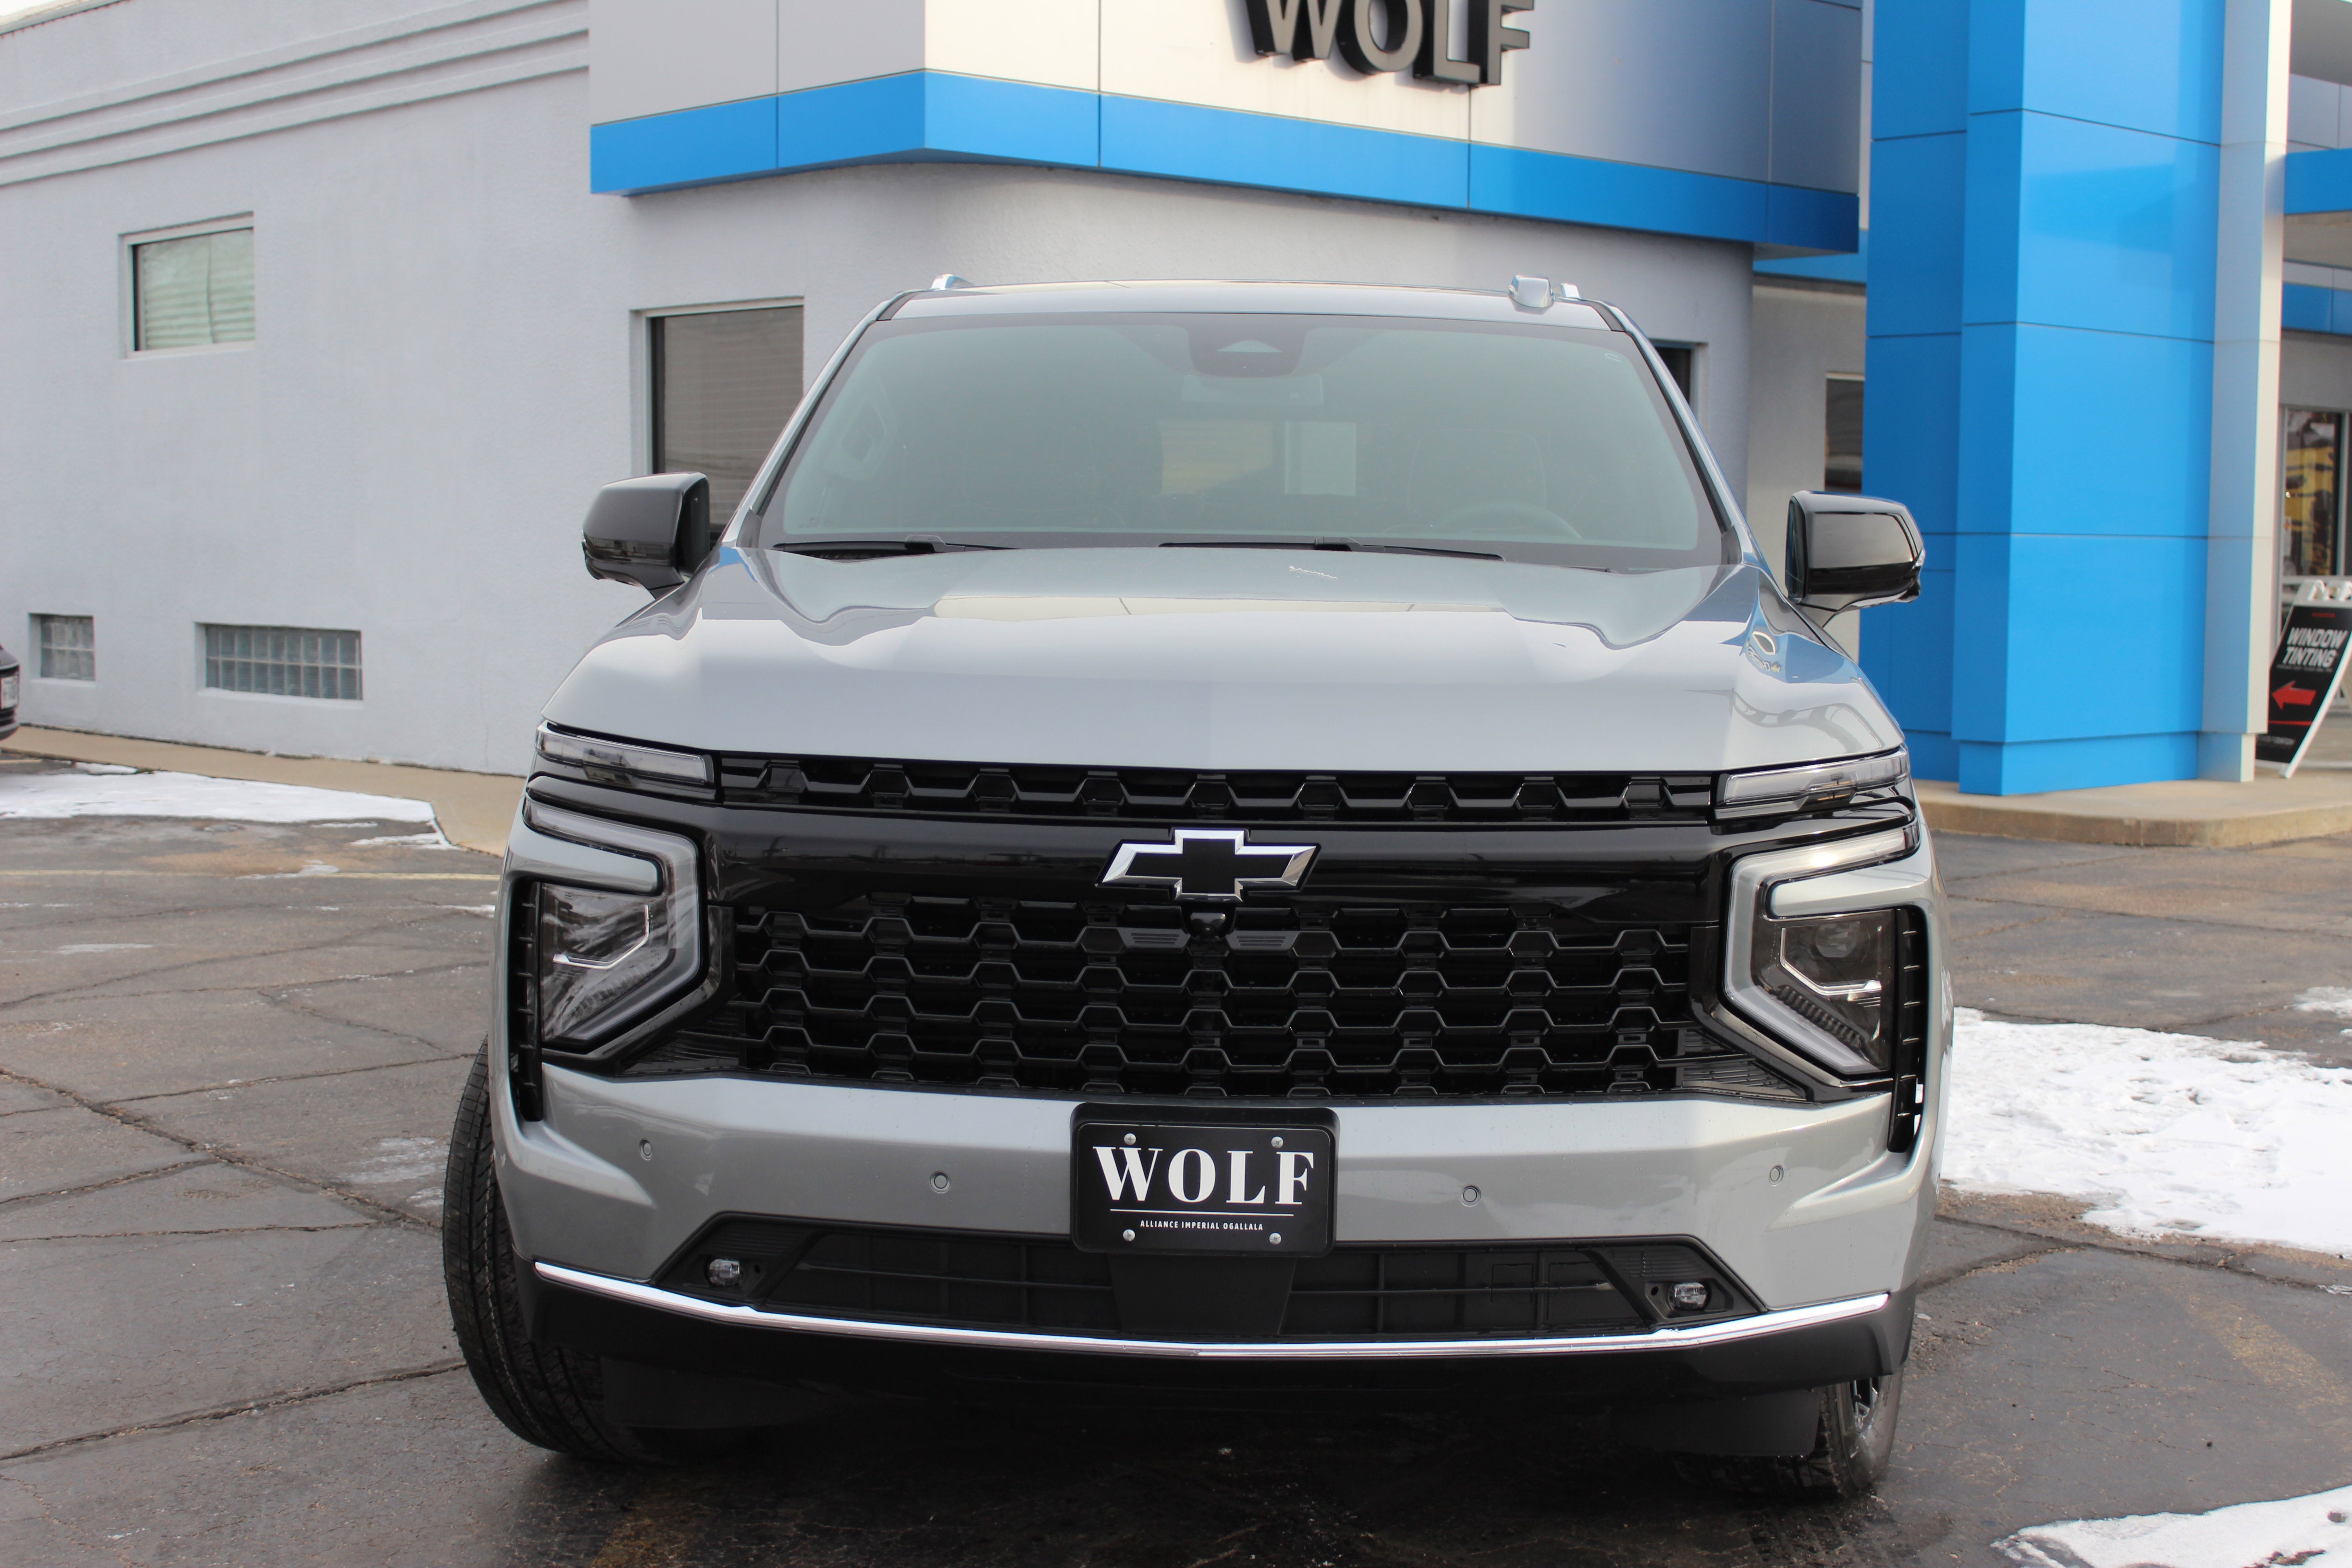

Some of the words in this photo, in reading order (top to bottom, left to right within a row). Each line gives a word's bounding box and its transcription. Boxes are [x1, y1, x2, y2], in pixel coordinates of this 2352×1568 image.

[1245, 0, 1534, 86] WOLF
[2287, 627, 2348, 649] WINDOW
[2282, 646, 2337, 668] TINTING
[1093, 1146, 1314, 1205] WOLF
[1140, 1220, 1179, 1229] ALLIANCE
[1181, 1221, 1220, 1230] IMPERIAL
[1223, 1222, 1264, 1231] OGALLALA
